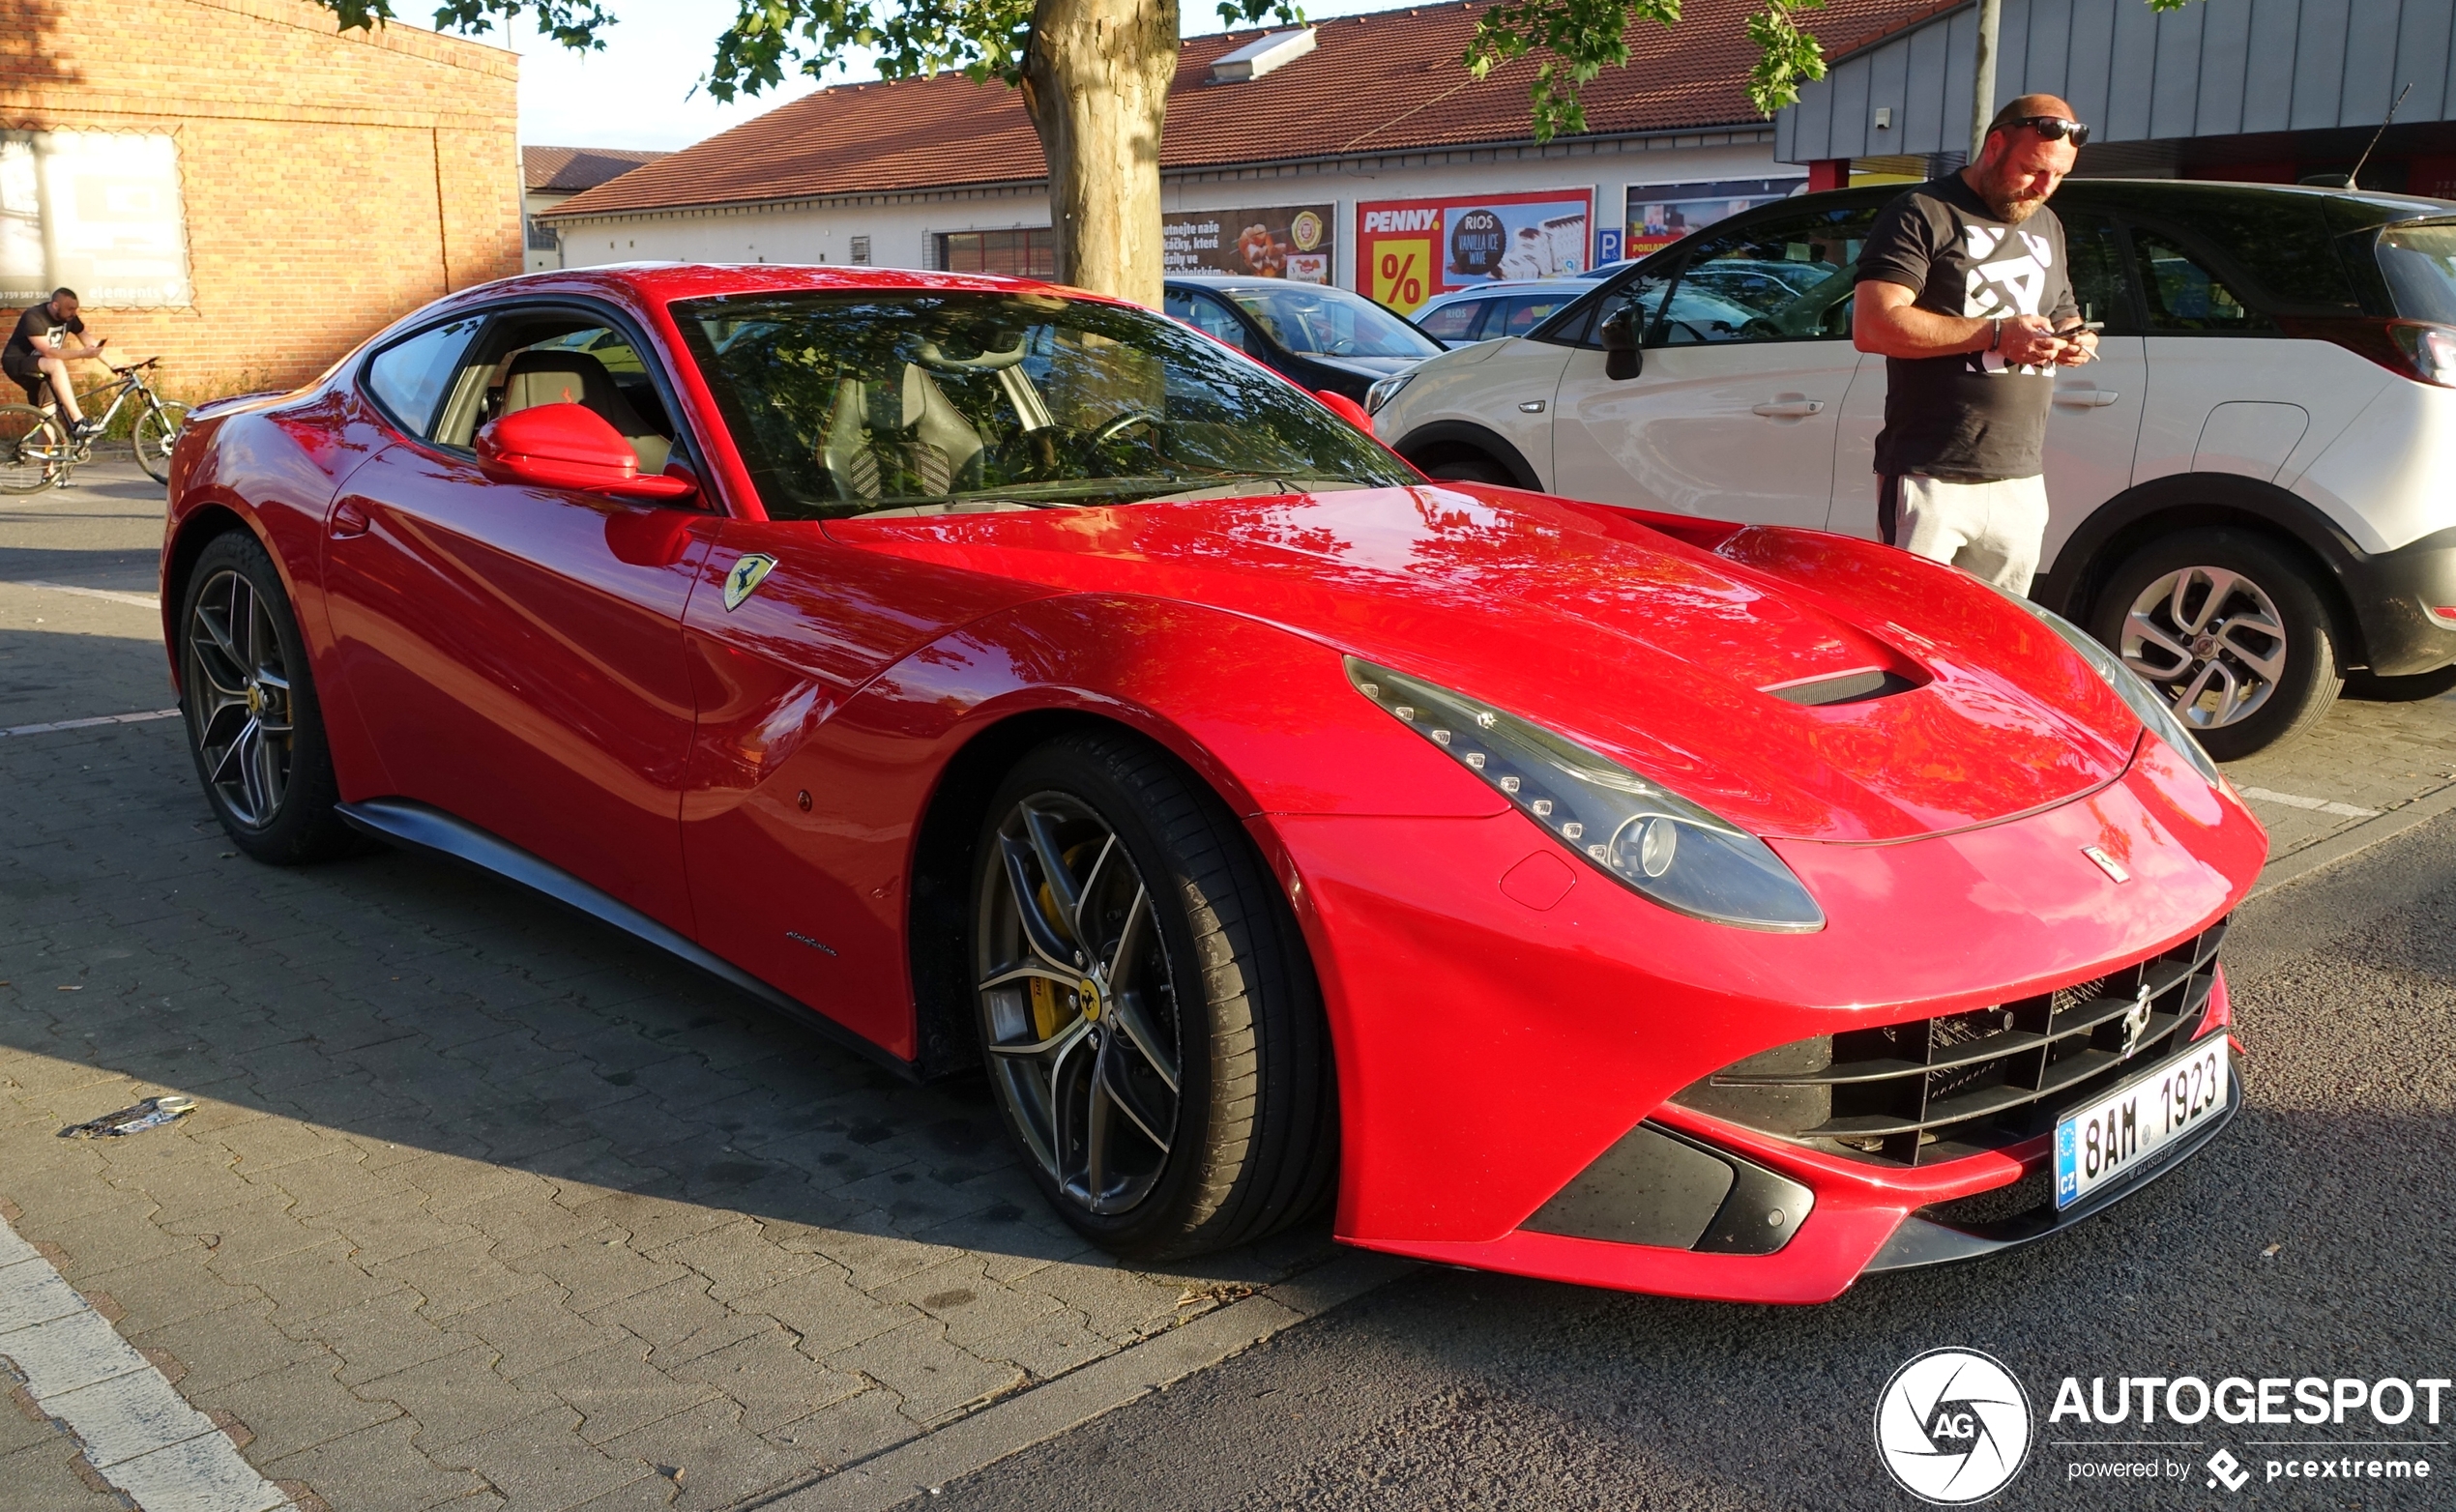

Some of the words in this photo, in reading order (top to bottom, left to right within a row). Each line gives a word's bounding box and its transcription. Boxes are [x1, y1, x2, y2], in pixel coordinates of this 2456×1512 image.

[1163, 221, 1196, 237] utnejte
[1197, 219, 1220, 235] naše
[1464, 215, 1494, 230] RIOS
[1193, 235, 1219, 249] které
[1458, 233, 1487, 251] VANILLA
[1488, 233, 1499, 250] ICE
[1602, 234, 1618, 259] P
[1186, 254, 1199, 264] ve
[1469, 251, 1487, 265] WAVE
[88, 285, 161, 299] elements
[1446, 307, 1467, 319] RIOS
[2086, 1096, 2137, 1178] 8AM
[2161, 1052, 2216, 1134] 1923
[2061, 1171, 2075, 1195] CZ
